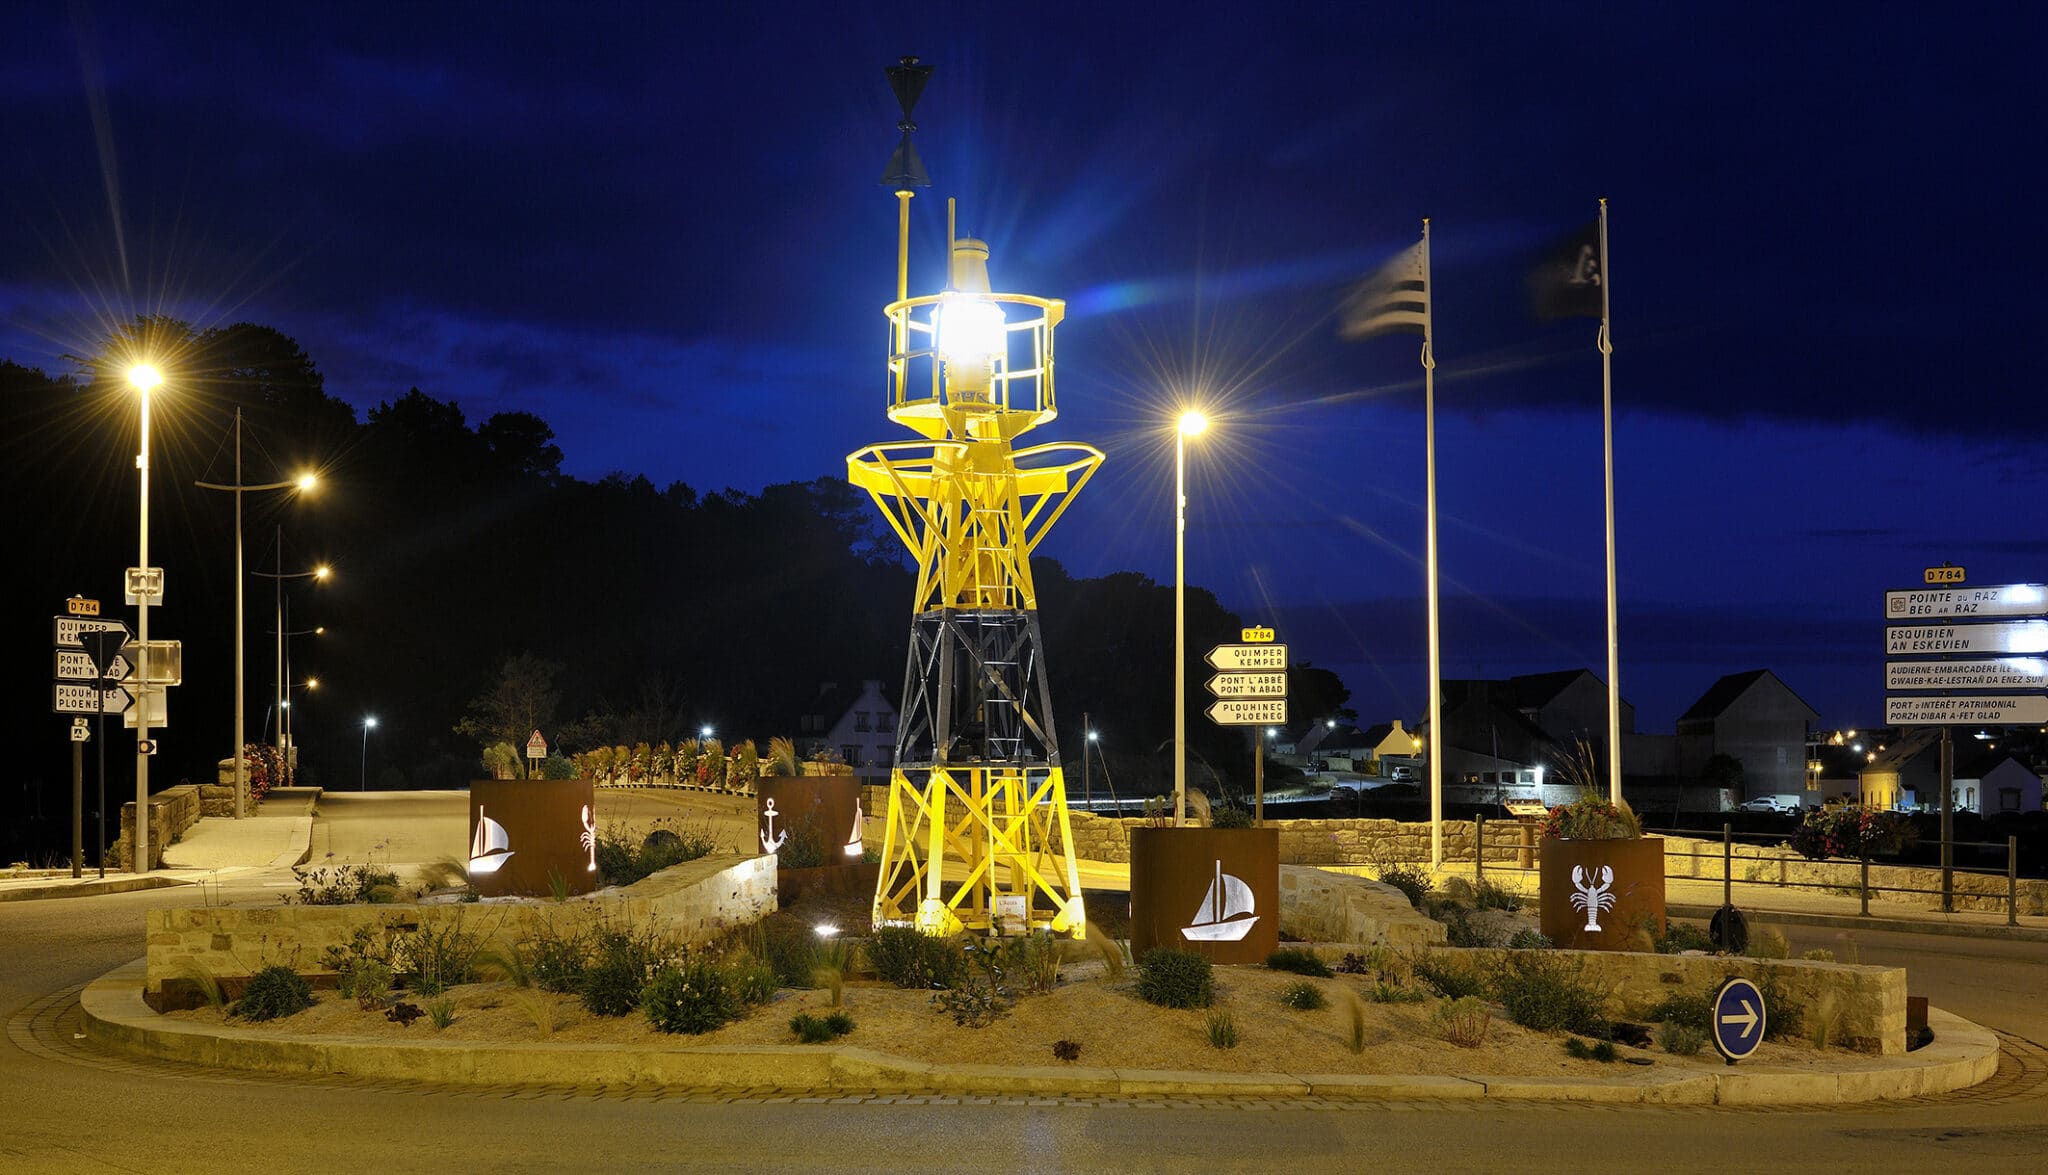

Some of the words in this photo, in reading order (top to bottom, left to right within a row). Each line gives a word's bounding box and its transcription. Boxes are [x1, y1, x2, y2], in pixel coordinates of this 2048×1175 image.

[1927, 570, 1935, 581] D
[1938, 569, 1962, 580] 784
[1909, 592, 1952, 603] POINTE
[1974, 591, 1998, 601] RAZ
[71, 602, 76, 611] D
[79, 603, 97, 612] 784
[1909, 605, 1932, 615] BEG
[1955, 603, 1978, 613] RAZ
[1245, 631, 1250, 639] D
[1253, 631, 1271, 639] 784
[1890, 628, 1954, 640] ESQUIBIEN
[1890, 641, 1907, 651] AN
[1912, 639, 1970, 650] ESKEVIEN
[1234, 649, 1282, 657] QUIMPER
[60, 655, 85, 665] PONT
[1240, 658, 1282, 666] KEMPER
[60, 666, 83, 676] PONT
[1220, 676, 1245, 684] PONT
[1986, 675, 1998, 684] DA
[2001, 675, 2023, 684] ENEZ
[59, 688, 117, 699] PLOUHIEC
[1220, 685, 1244, 694] PONT
[1259, 685, 1283, 693] ABAD
[59, 699, 104, 709] PLOENE
[1223, 703, 1282, 712] PLOUHINEC
[1890, 701, 1913, 709] PORT
[1958, 700, 2017, 709] PATRIMONIAL
[1236, 712, 1283, 721] PLOENEG
[1890, 712, 1919, 720] PORZH
[1920, 712, 1947, 720] DIBAR
[1977, 711, 2001, 720] GLAD
